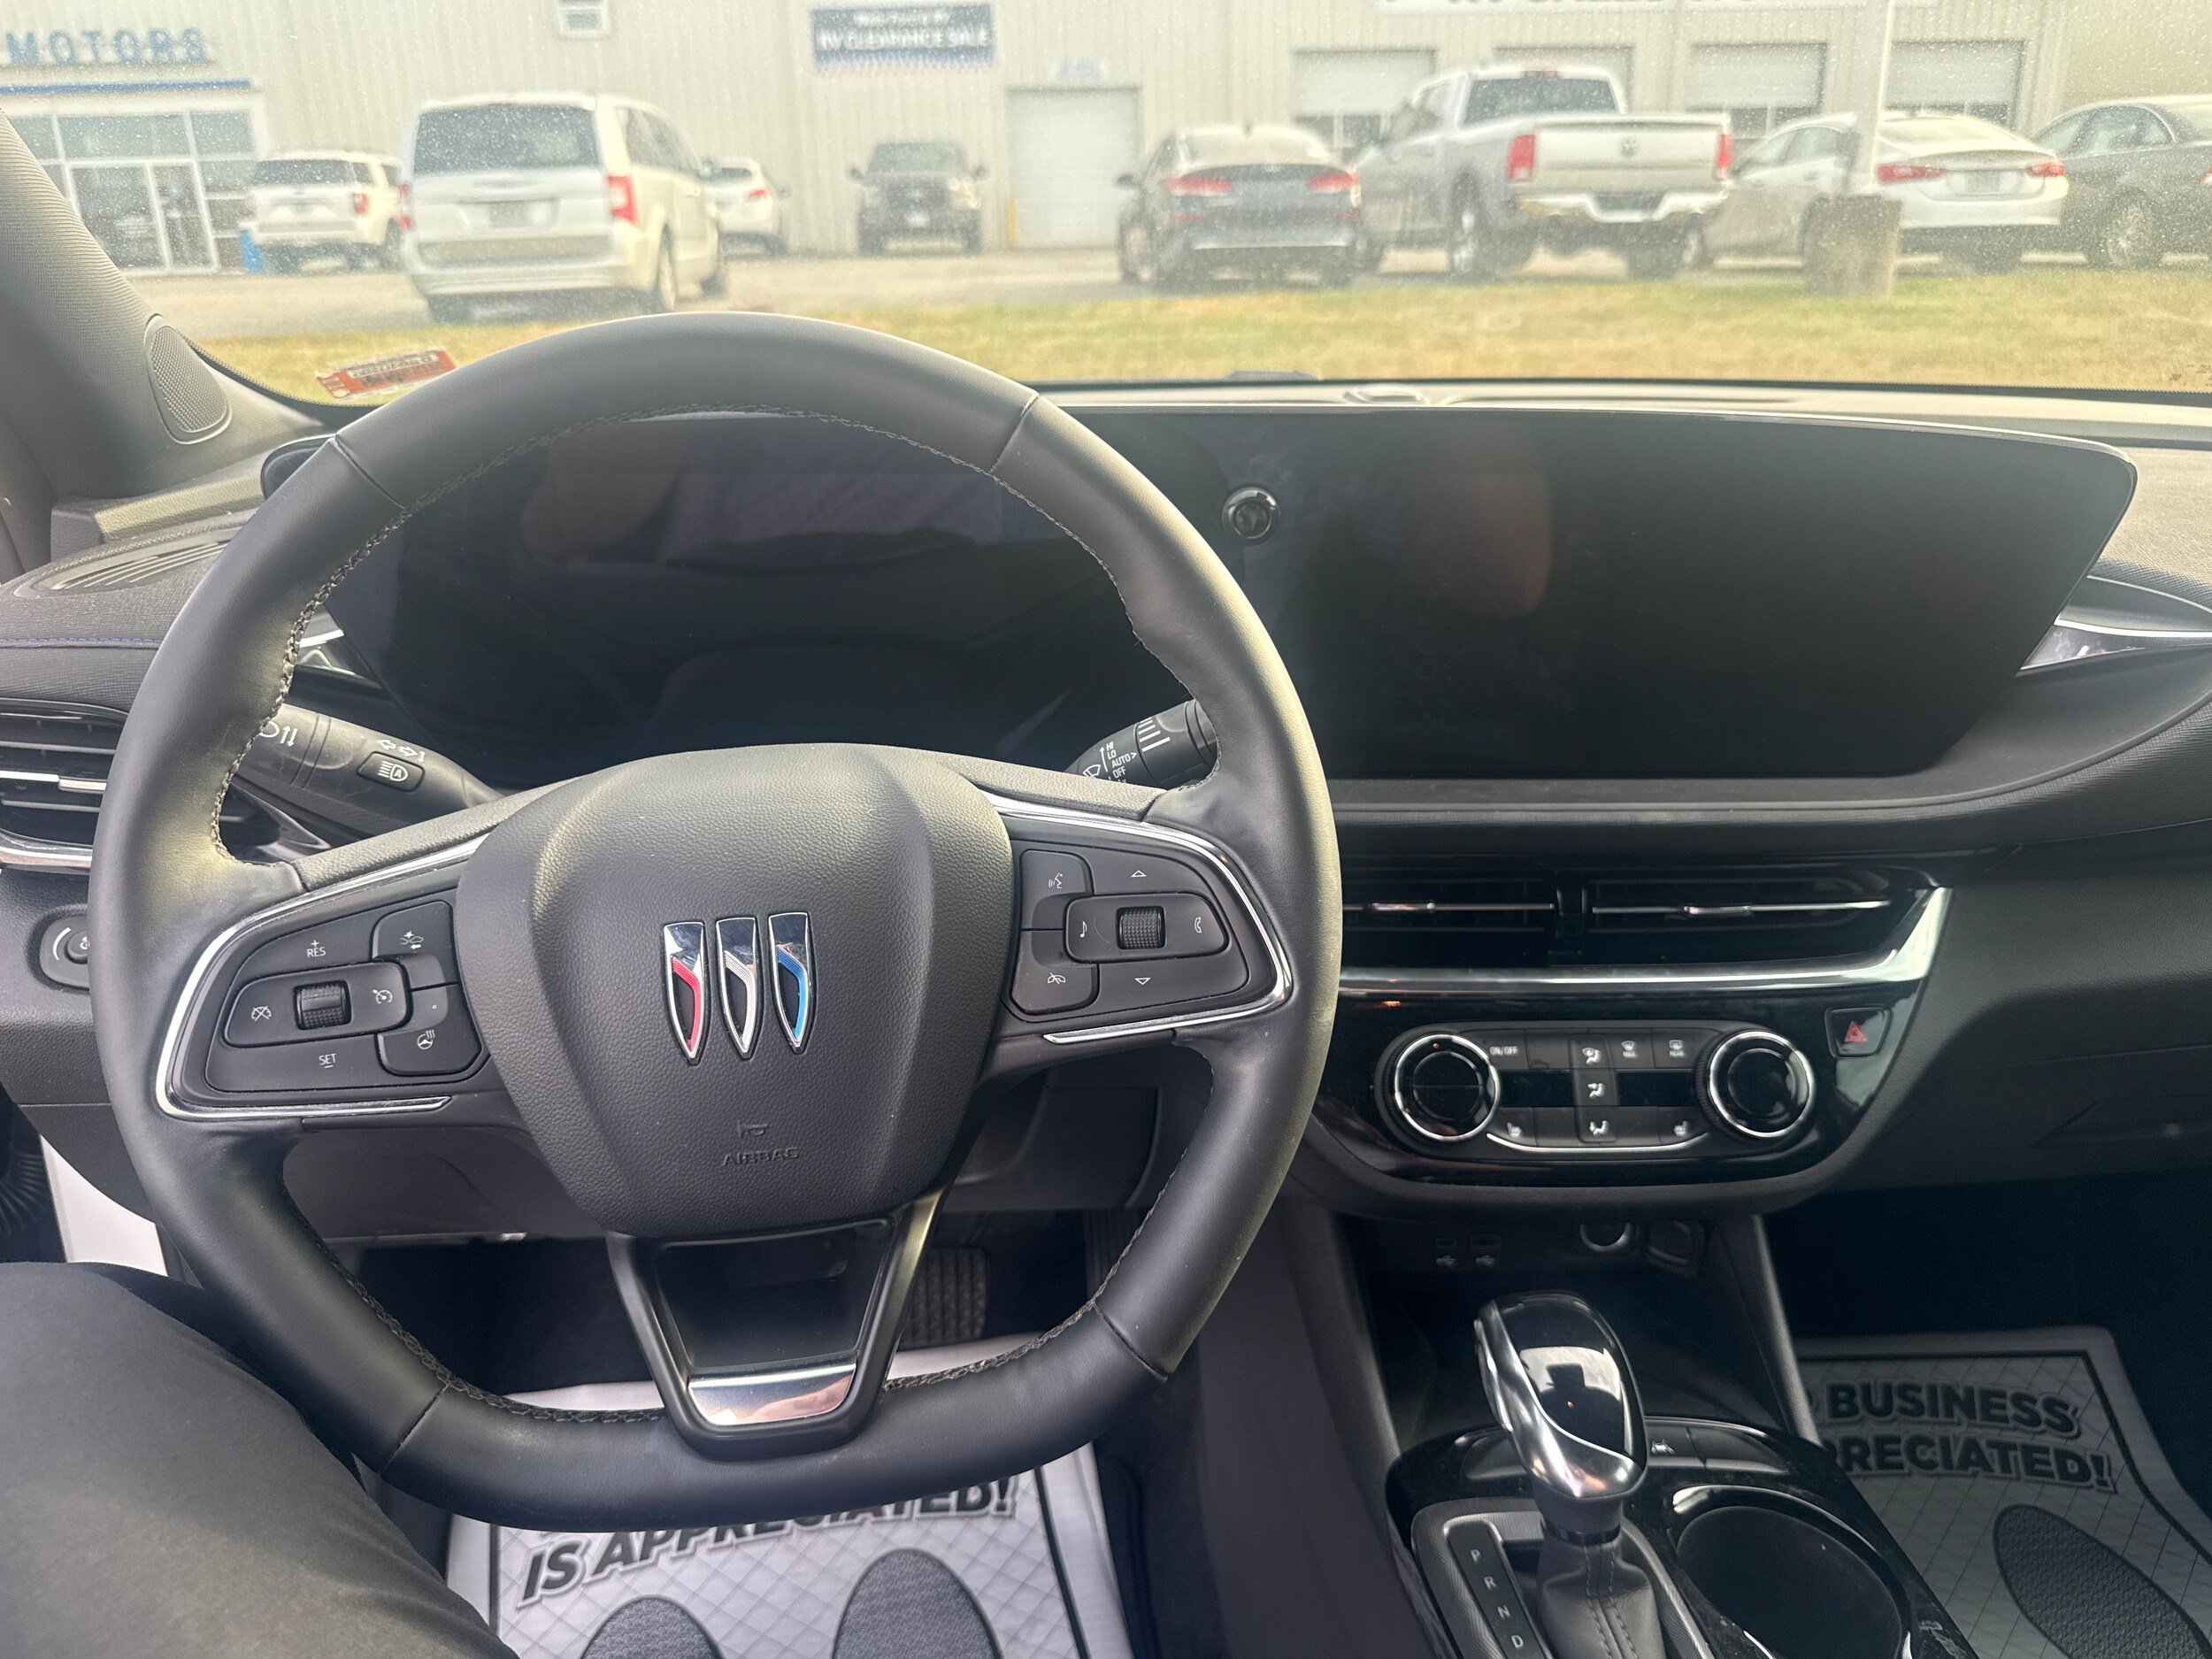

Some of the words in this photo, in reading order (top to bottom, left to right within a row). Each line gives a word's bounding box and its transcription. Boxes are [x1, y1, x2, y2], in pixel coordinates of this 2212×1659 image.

[5, 27, 208, 66] MOTORS
[1106, 741, 1113, 750] HI
[1107, 750, 1117, 760] LO
[1111, 753, 1131, 768] AUTO
[1112, 766, 1125, 778] OFF
[307, 947, 326, 957] RES
[1490, 1046, 1518, 1056] ON/OFF
[319, 1053, 336, 1065] SET
[722, 1148, 800, 1166] AIRBAG
[1826, 1381, 2078, 1434] BUSINESS
[1824, 1434, 2112, 1488] RECIATED!
[1471, 1549, 1481, 1563] P
[519, 1540, 588, 1601] IS
[1484, 1576, 1497, 1589] R
[1497, 1605, 1510, 1618] N
[1511, 1635, 1524, 1648] D
